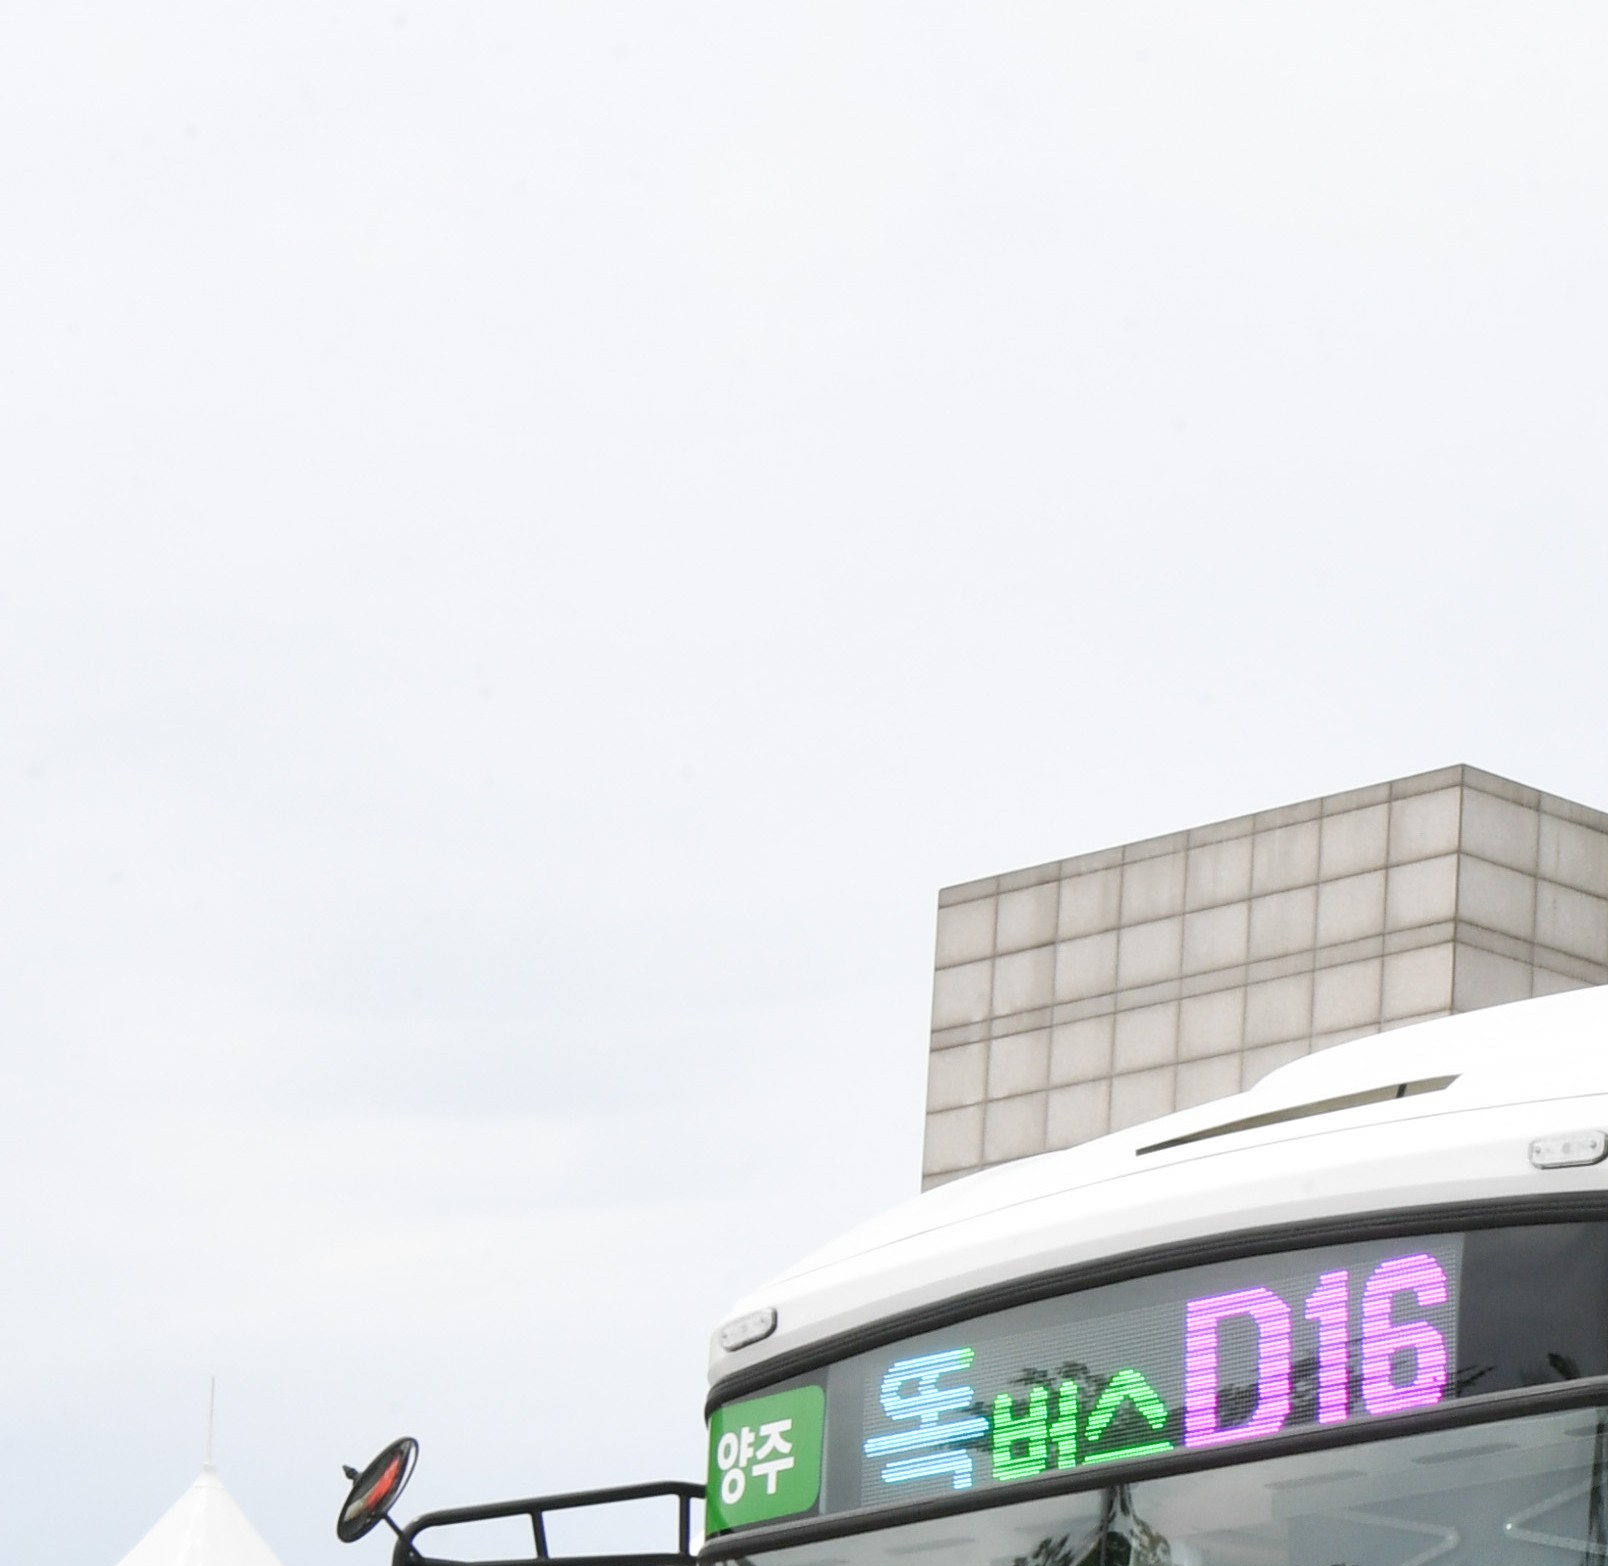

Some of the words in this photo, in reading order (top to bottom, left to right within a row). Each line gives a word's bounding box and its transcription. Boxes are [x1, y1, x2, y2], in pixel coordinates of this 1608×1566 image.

[864, 1347, 1173, 1490] 똑버스
[1184, 1253, 1448, 1448] D16
[717, 1418, 792, 1504] 양주
